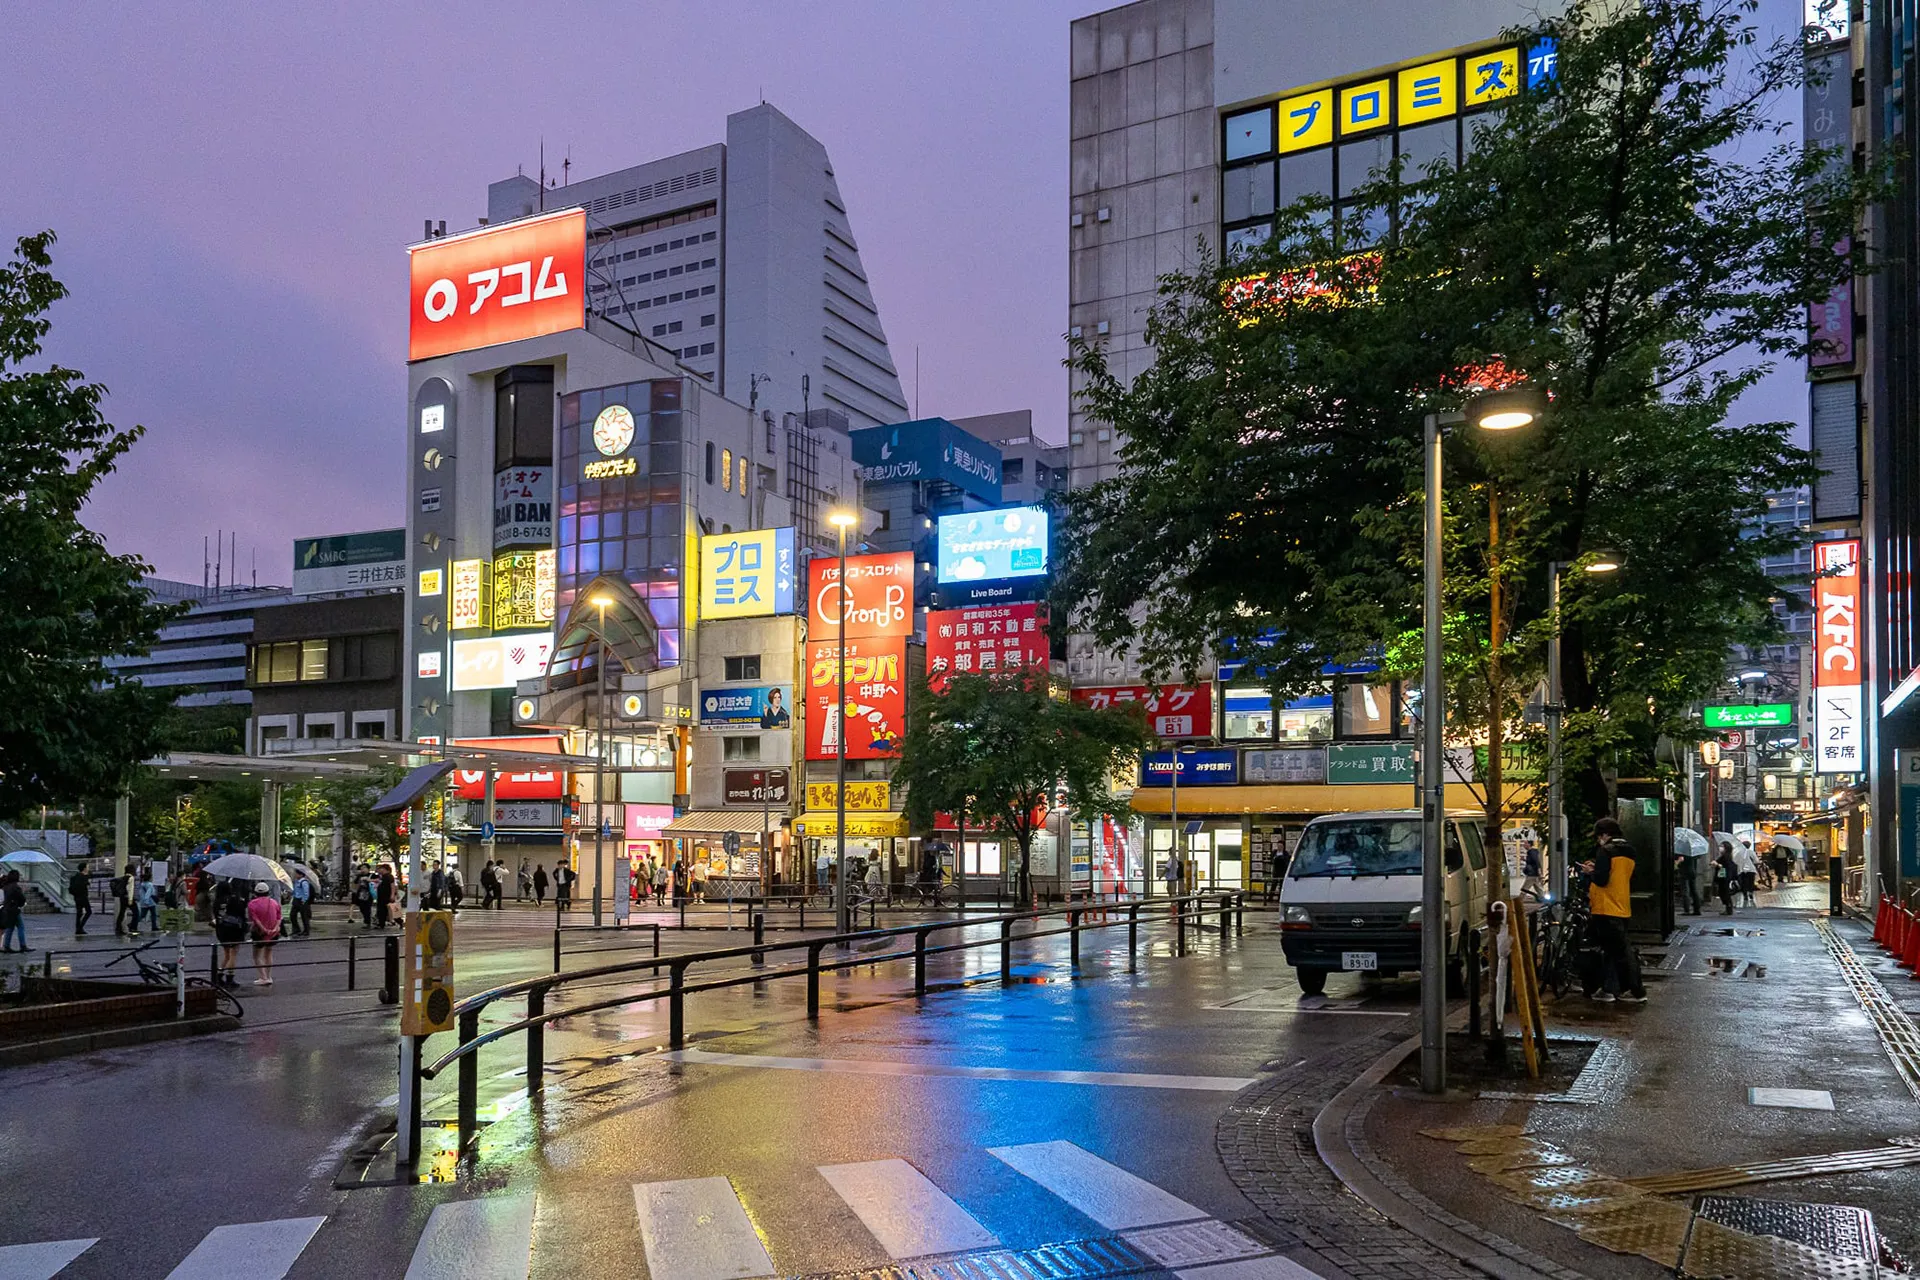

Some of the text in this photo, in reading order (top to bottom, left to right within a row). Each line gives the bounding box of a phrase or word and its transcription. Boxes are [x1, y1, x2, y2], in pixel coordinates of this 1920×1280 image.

[1529, 53, 1557, 76] 7F
[1289, 60, 1507, 138] プロミス
[467, 255, 569, 315] アコム
[863, 461, 921, 482] 東急リバブル
[954, 447, 998, 485] 東急リバブル
[515, 503, 551, 522] BAN
[318, 549, 346, 564] SMBC
[779, 548, 791, 576] すぐ
[971, 587, 1013, 598] Live Board
[456, 597, 478, 617] 550
[1823, 592, 1856, 672] KFC
[932, 649, 1043, 672] お部屋探し
[812, 654, 898, 688] グランパ
[860, 683, 899, 699] 中野へ
[1165, 723, 1183, 734] B1
[1829, 727, 1851, 740] 2F
[1825, 745, 1856, 759] 客席
[1149, 762, 1185, 771] MIZUO
[1371, 756, 1407, 772] 買取
[508, 808, 541, 821] 文明堂
